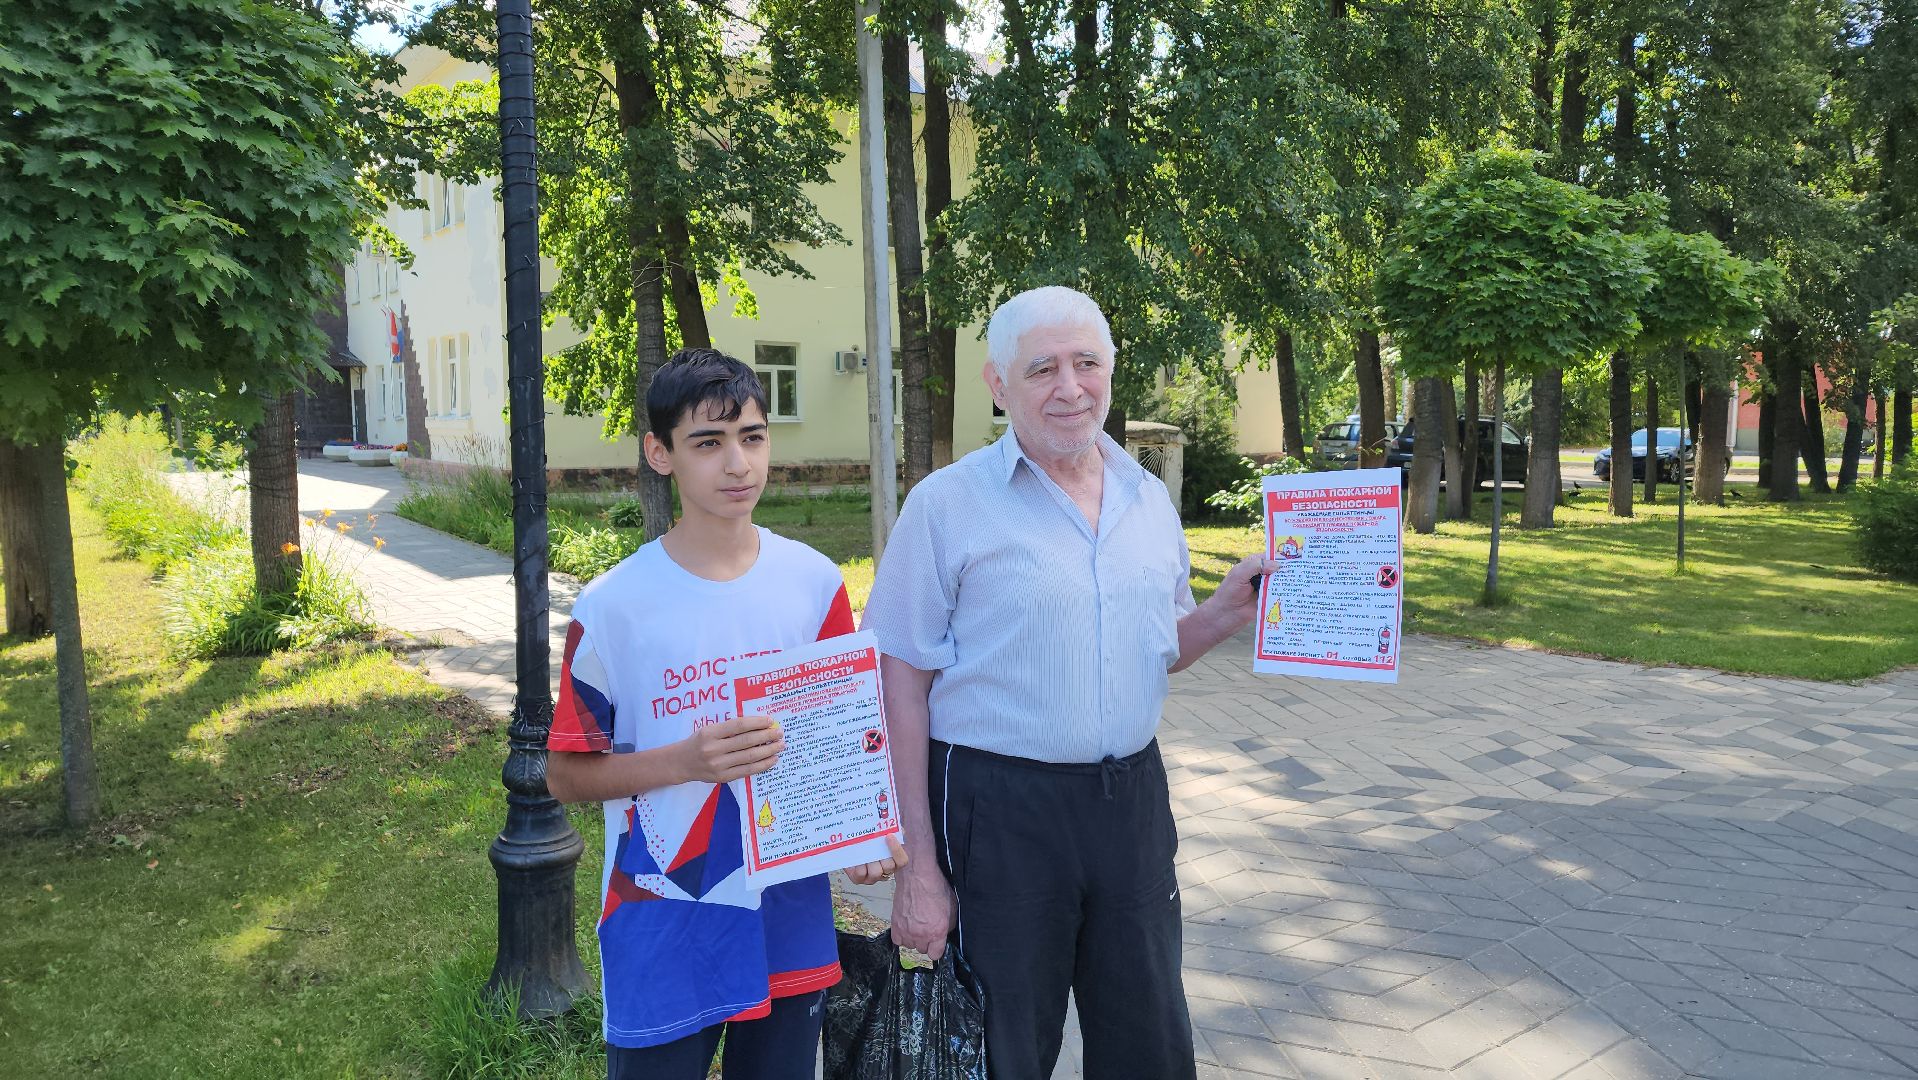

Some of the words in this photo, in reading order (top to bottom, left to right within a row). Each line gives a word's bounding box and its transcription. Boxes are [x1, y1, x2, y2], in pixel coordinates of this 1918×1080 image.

[1276, 488, 1327, 500] ПРАВИЛА
[1329, 486, 1392, 497] ПОЖАРНОЙ
[1291, 499, 1377, 511] БЕЗОПАСНОСТИ
[747, 664, 801, 687] ПРАВИЛА
[804, 649, 868, 672] ПОЖАРНОЙ
[1326, 651, 1338, 660] 01
[1374, 655, 1393, 664] 112
[765, 665, 854, 696] БЕЗОПАСНОСТИ
[760, 854, 773, 864] ПРИ
[829, 832, 843, 844] 01
[876, 818, 896, 830] 112
